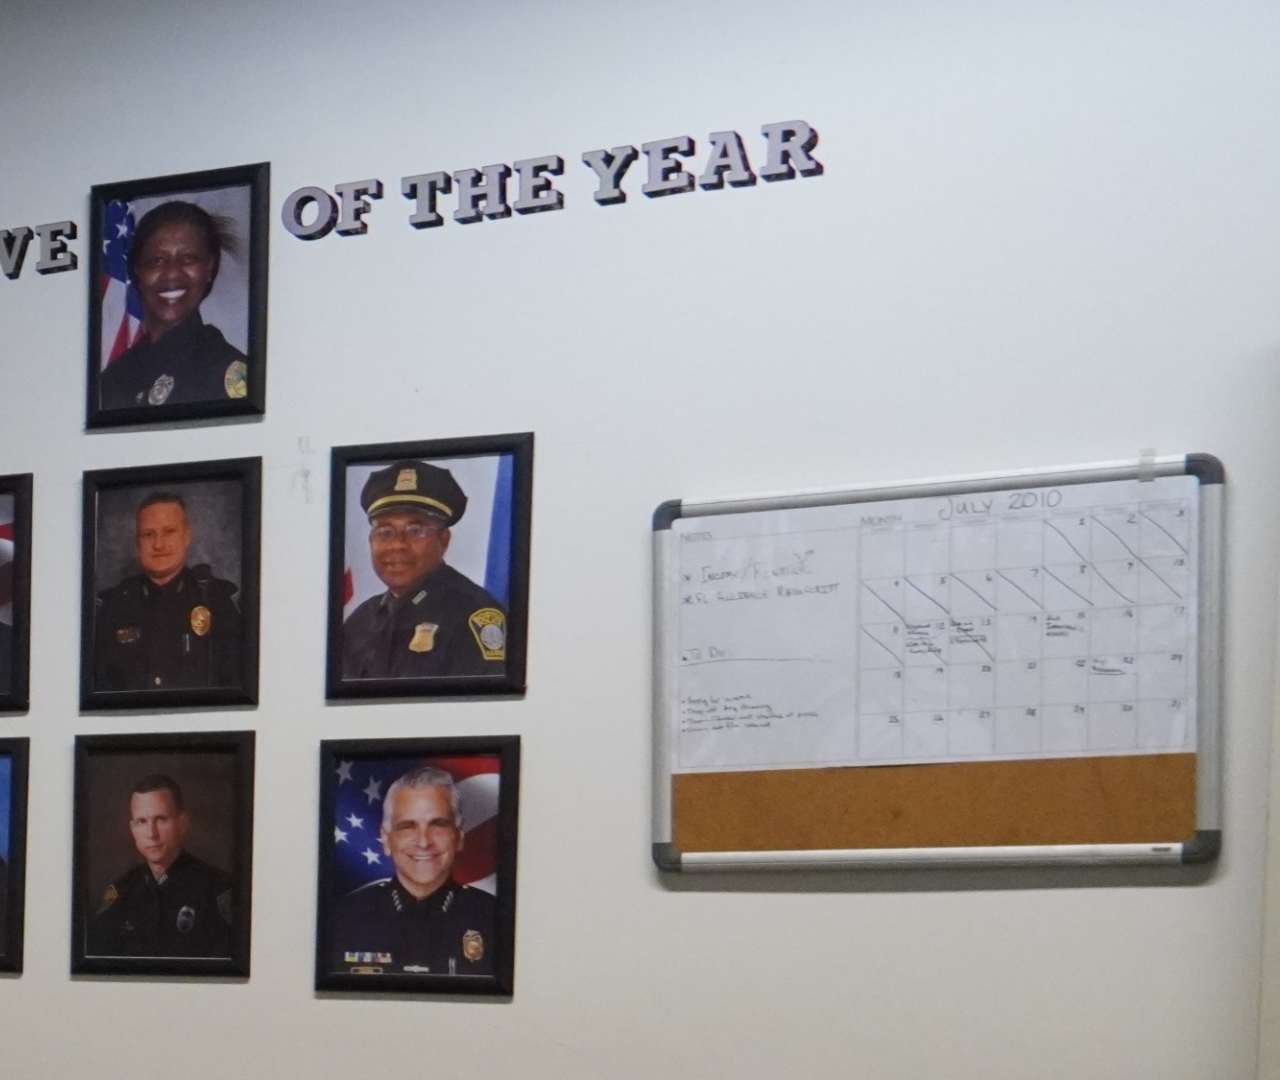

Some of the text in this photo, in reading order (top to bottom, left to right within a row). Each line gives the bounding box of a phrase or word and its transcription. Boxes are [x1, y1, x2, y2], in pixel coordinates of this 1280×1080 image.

[281, 178, 384, 241] OF
[400, 155, 565, 230] THE
[581, 118, 825, 206] YEAR
[1008, 489, 1062, 510] 2010
[1126, 513, 1137, 524] 2
